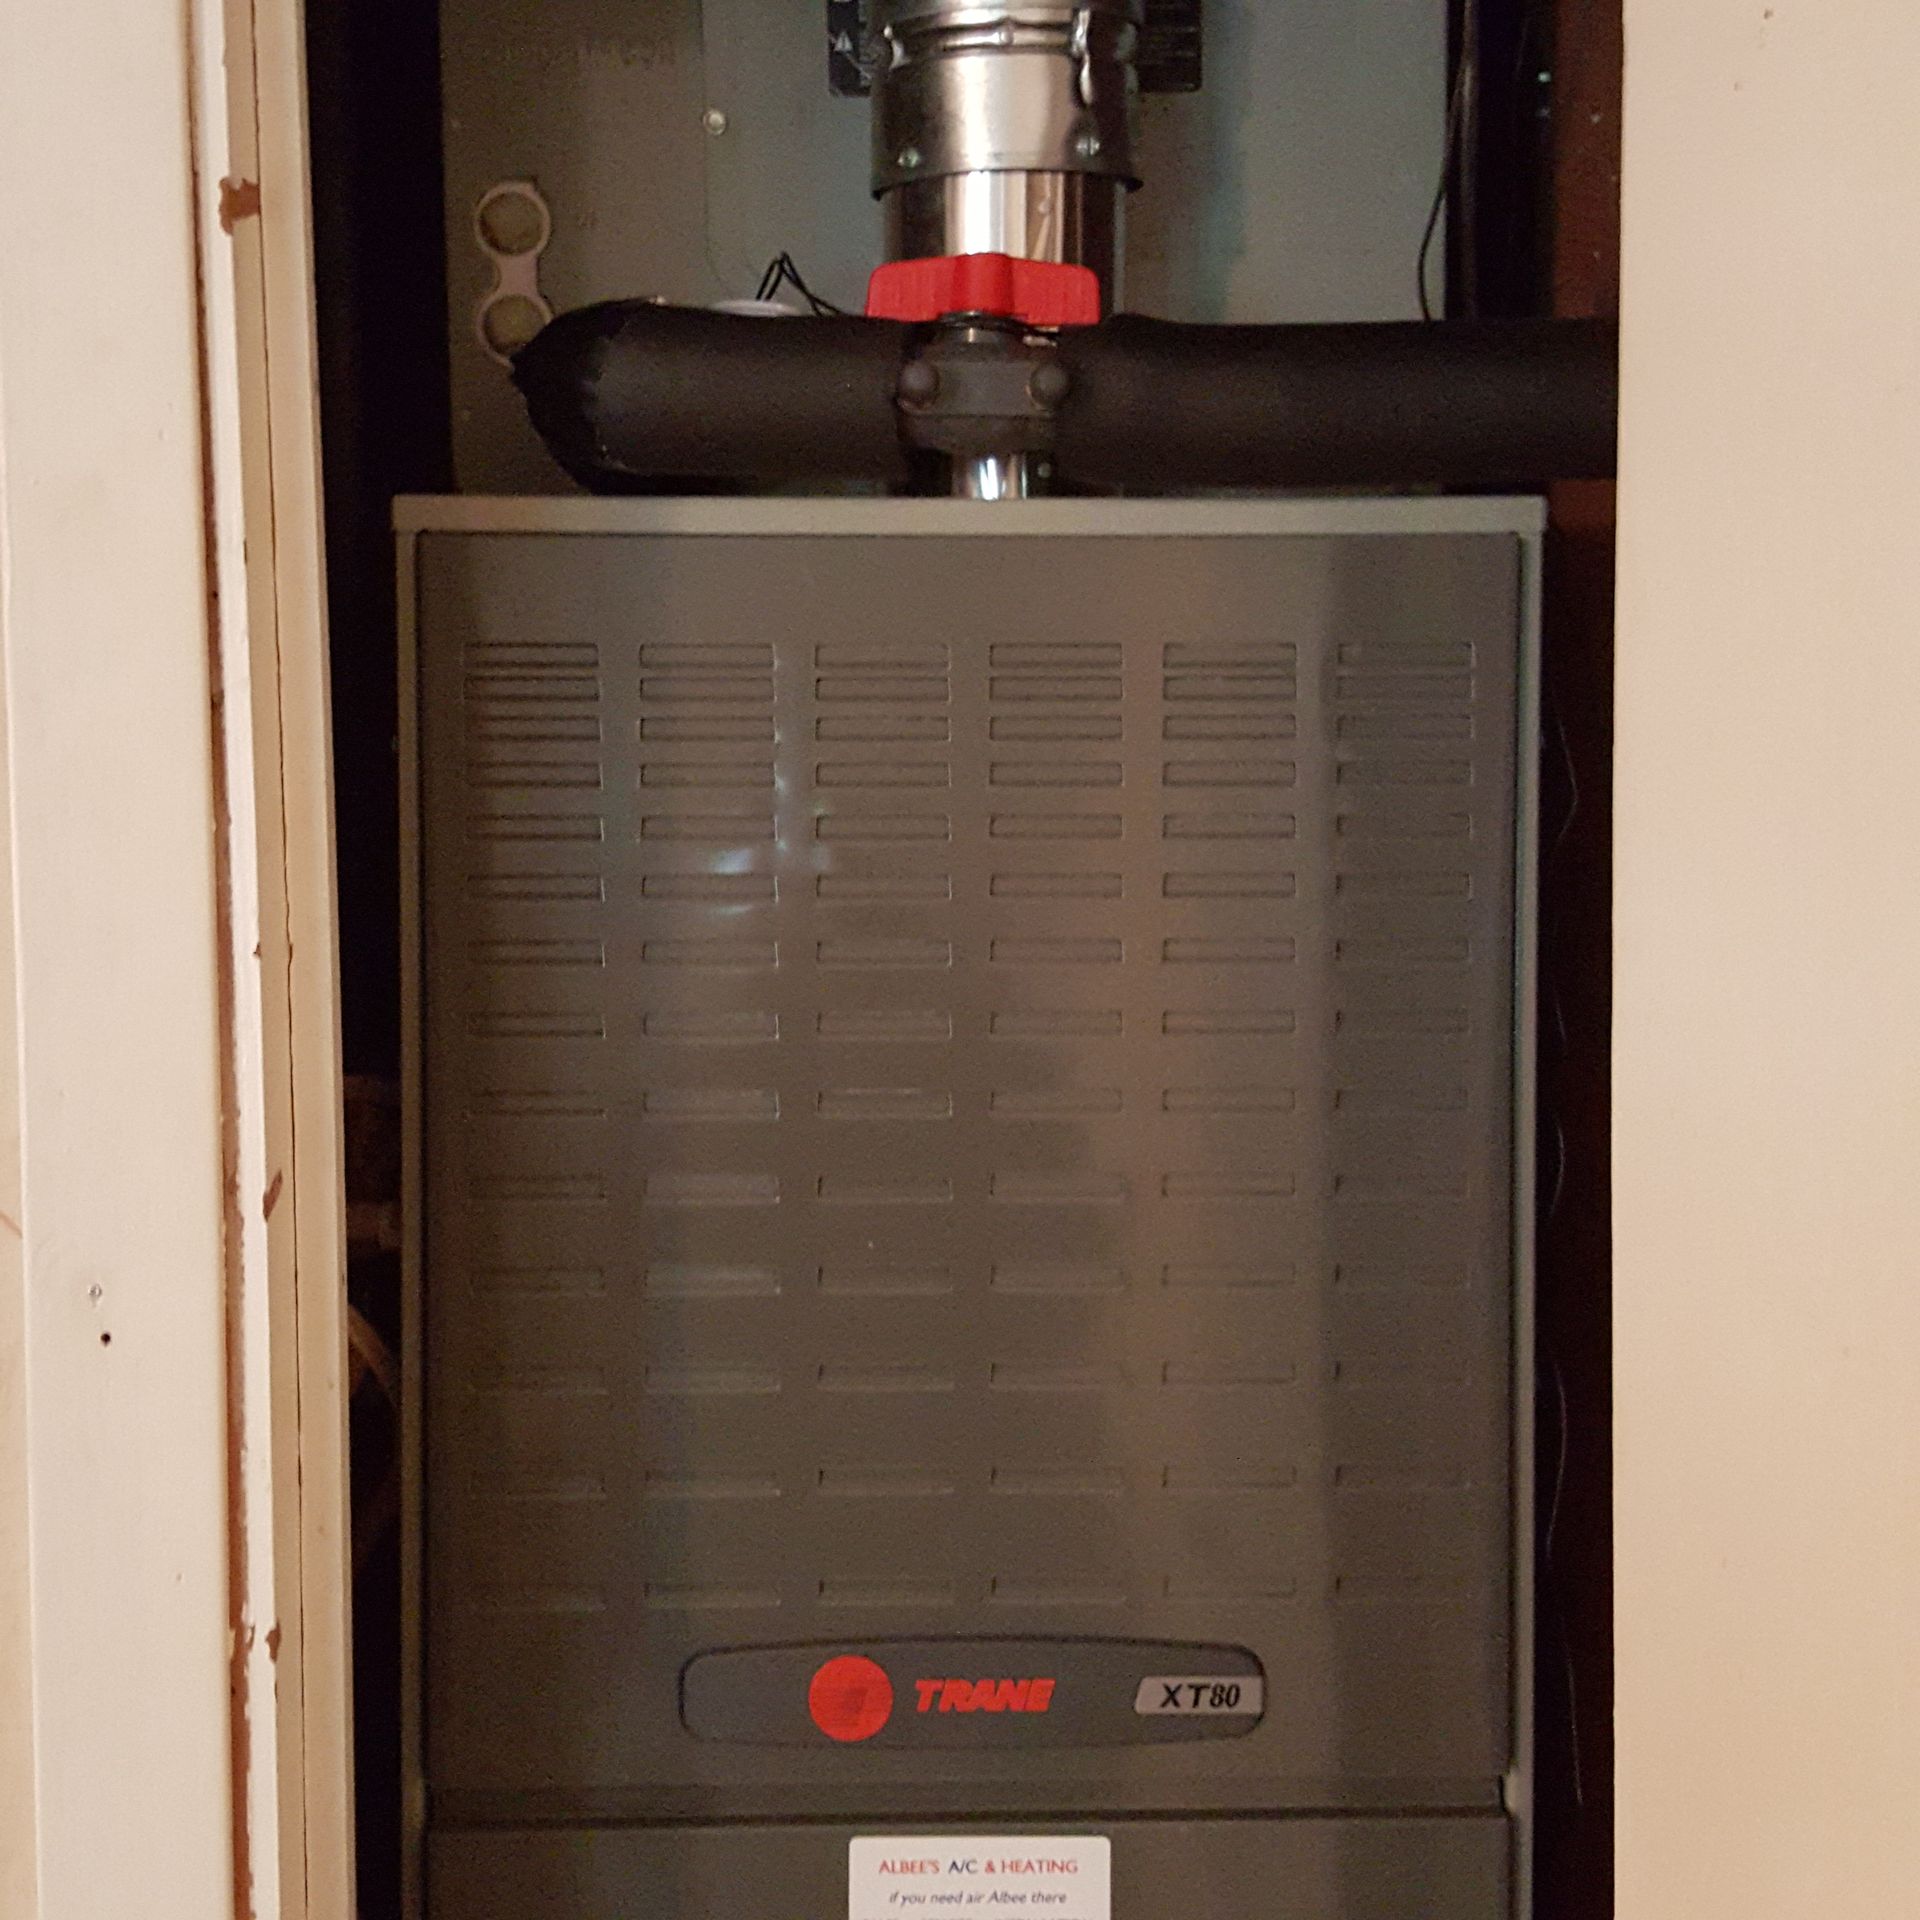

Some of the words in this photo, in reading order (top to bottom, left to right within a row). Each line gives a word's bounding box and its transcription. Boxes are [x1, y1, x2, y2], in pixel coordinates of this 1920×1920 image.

[914, 1678, 1055, 1713] TRANE
[1159, 1683, 1241, 1709] XT80
[878, 1859, 940, 1874] ALBEE'S
[948, 1859, 978, 1874] A/C
[984, 1860, 996, 1874] &
[1001, 1859, 1079, 1874] HEATING
[889, 1890, 901, 1904] if
[900, 1893, 926, 1907] you
[930, 1890, 964, 1904] need
[966, 1891, 986, 1904] air
[987, 1889, 1027, 1904] Albee
[1031, 1890, 1067, 1904] there
